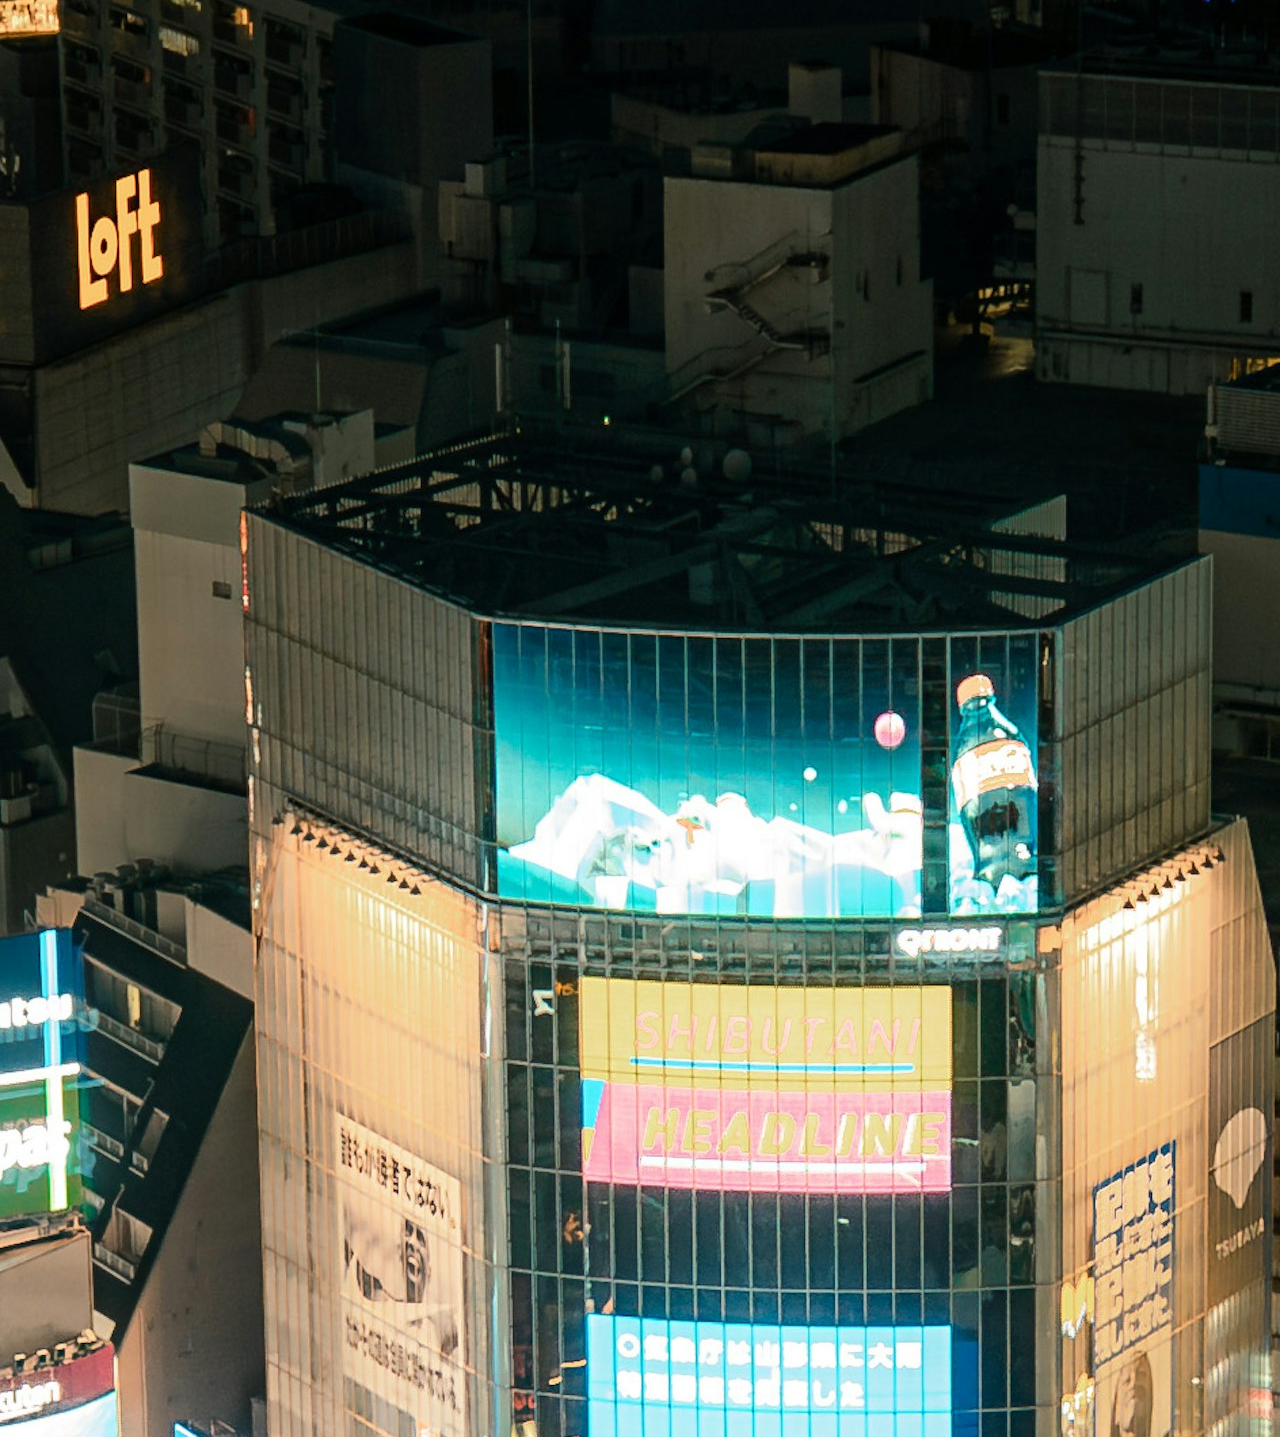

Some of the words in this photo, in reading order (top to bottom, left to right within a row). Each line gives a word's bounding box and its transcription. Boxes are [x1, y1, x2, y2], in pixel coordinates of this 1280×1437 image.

[635, 1011, 922, 1056] SHIBUTANI
[642, 1106, 947, 1159] HEADLINE
[1215, 1217, 1265, 1261] TSUTAYA
